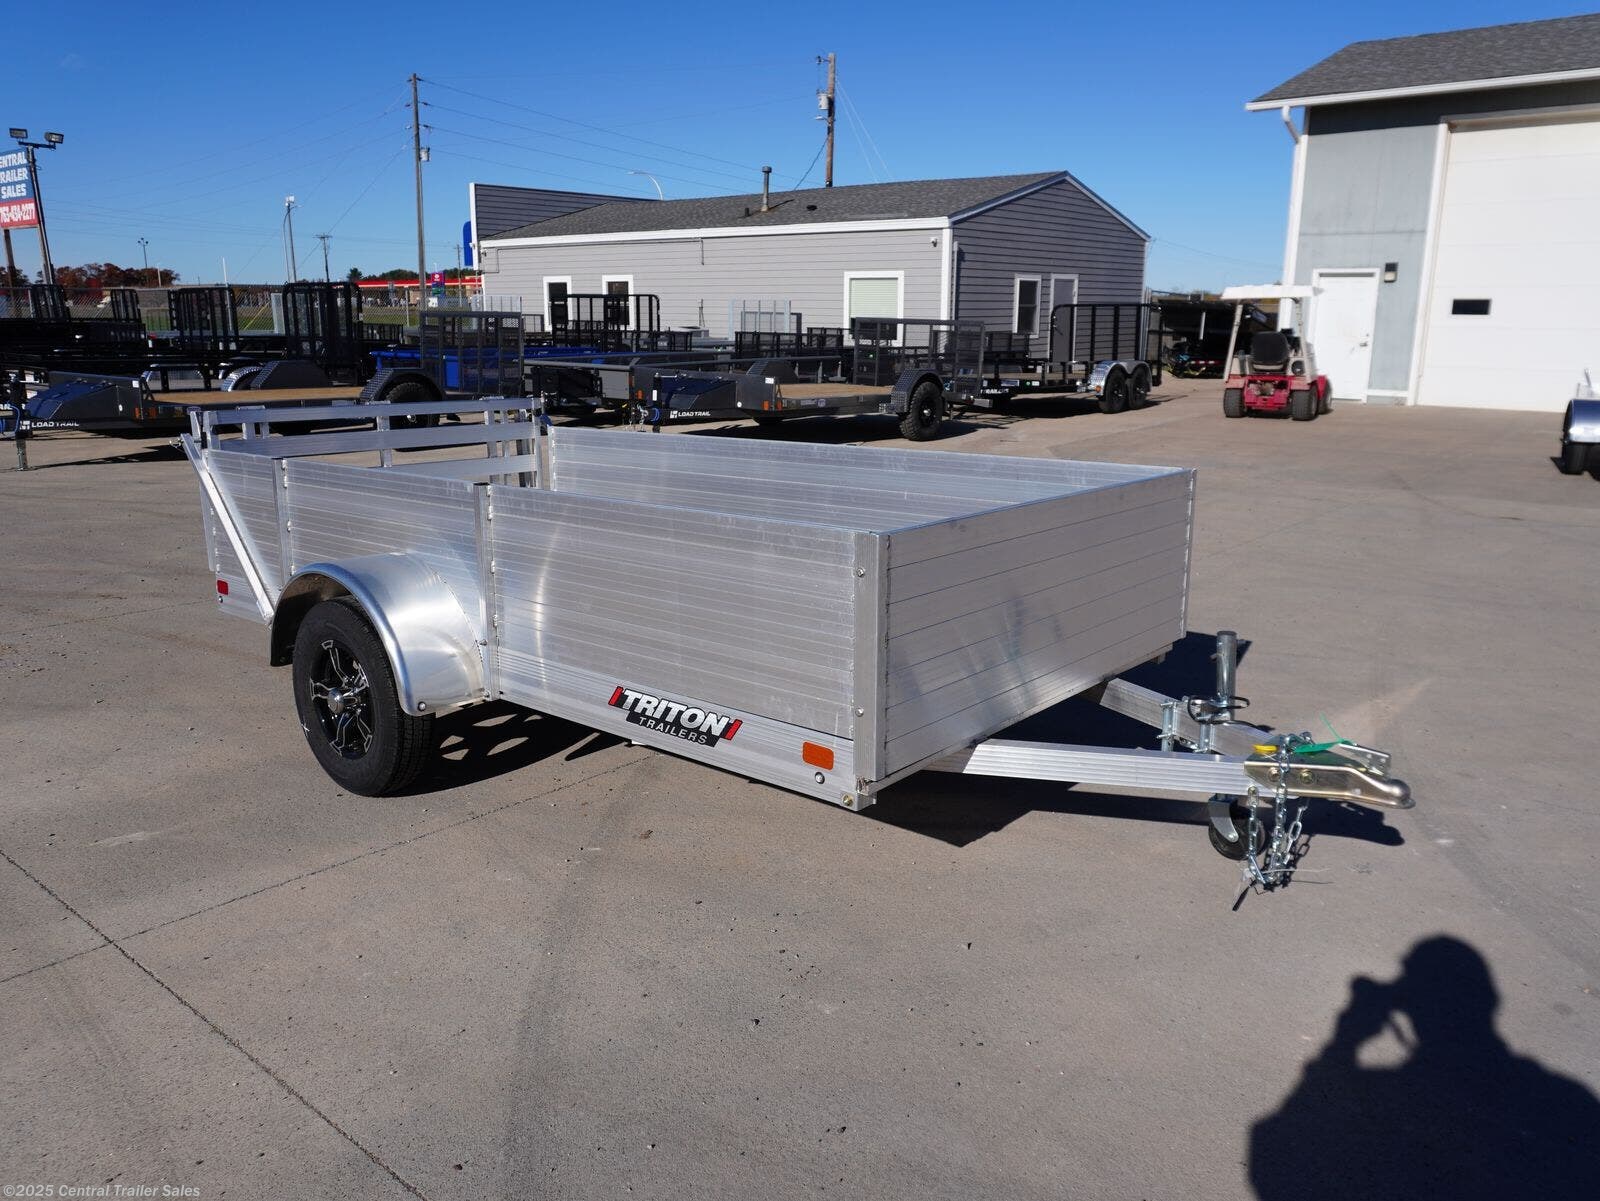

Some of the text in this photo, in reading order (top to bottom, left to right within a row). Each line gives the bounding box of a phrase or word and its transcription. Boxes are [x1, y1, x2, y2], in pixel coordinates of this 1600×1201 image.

[1, 184, 26, 199] SALES
[622, 689, 730, 737] TRITON
[639, 717, 708, 744] TRAILERS
